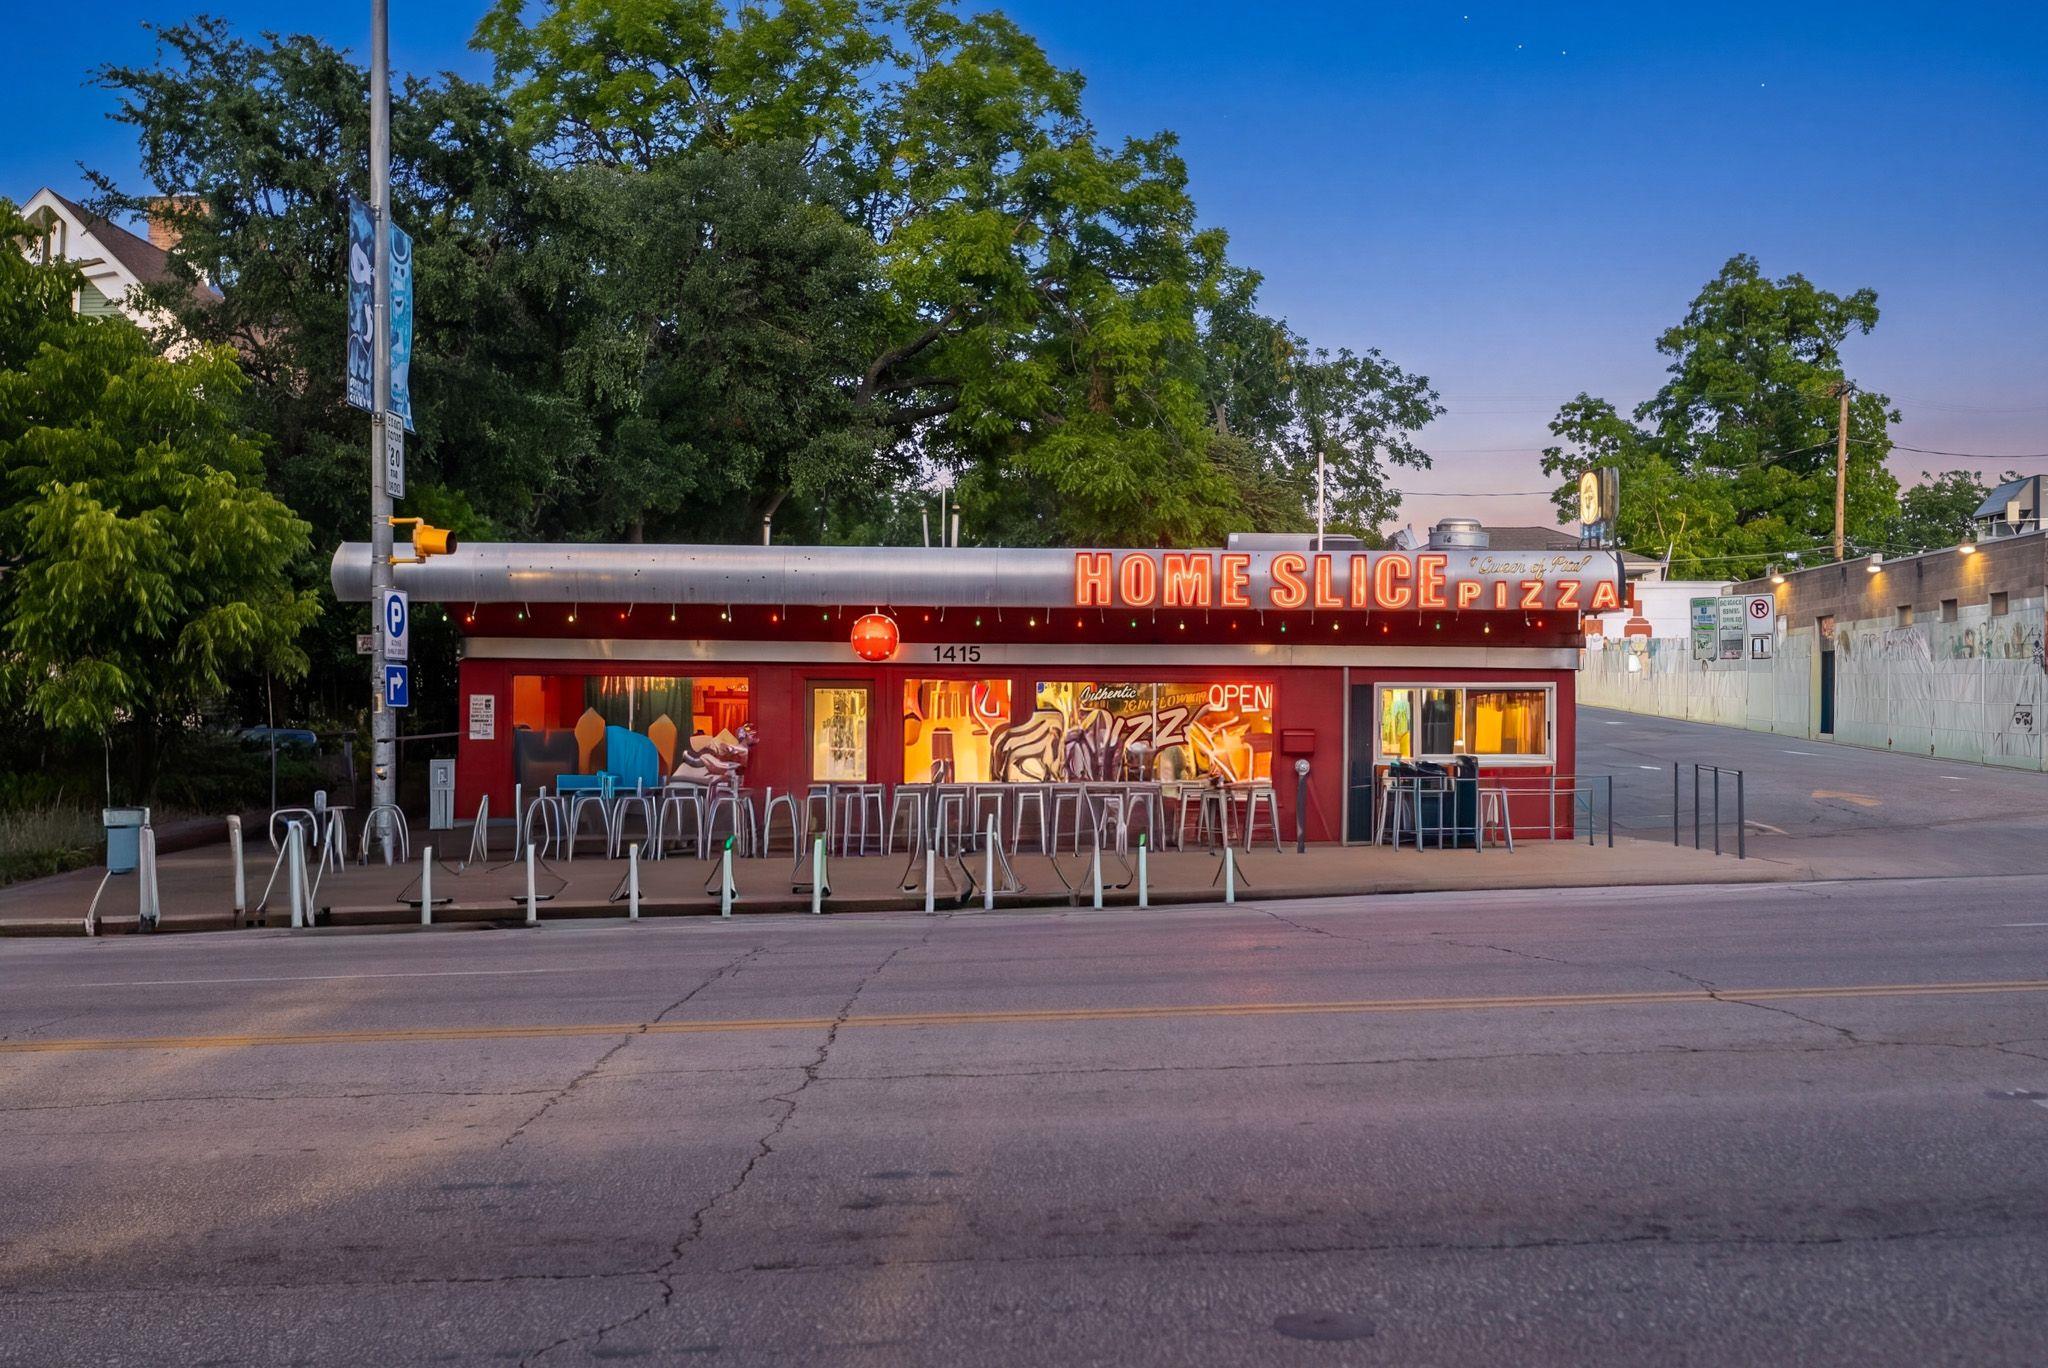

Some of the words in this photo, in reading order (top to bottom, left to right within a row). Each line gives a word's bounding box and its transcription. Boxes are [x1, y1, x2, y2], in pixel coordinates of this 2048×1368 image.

[1075, 552, 1251, 608] HOME
[1270, 553, 1448, 609] SLICE
[1457, 579, 1620, 609] PIZZA
[933, 645, 981, 662] 1415
[1208, 684, 1271, 712] OPEN
